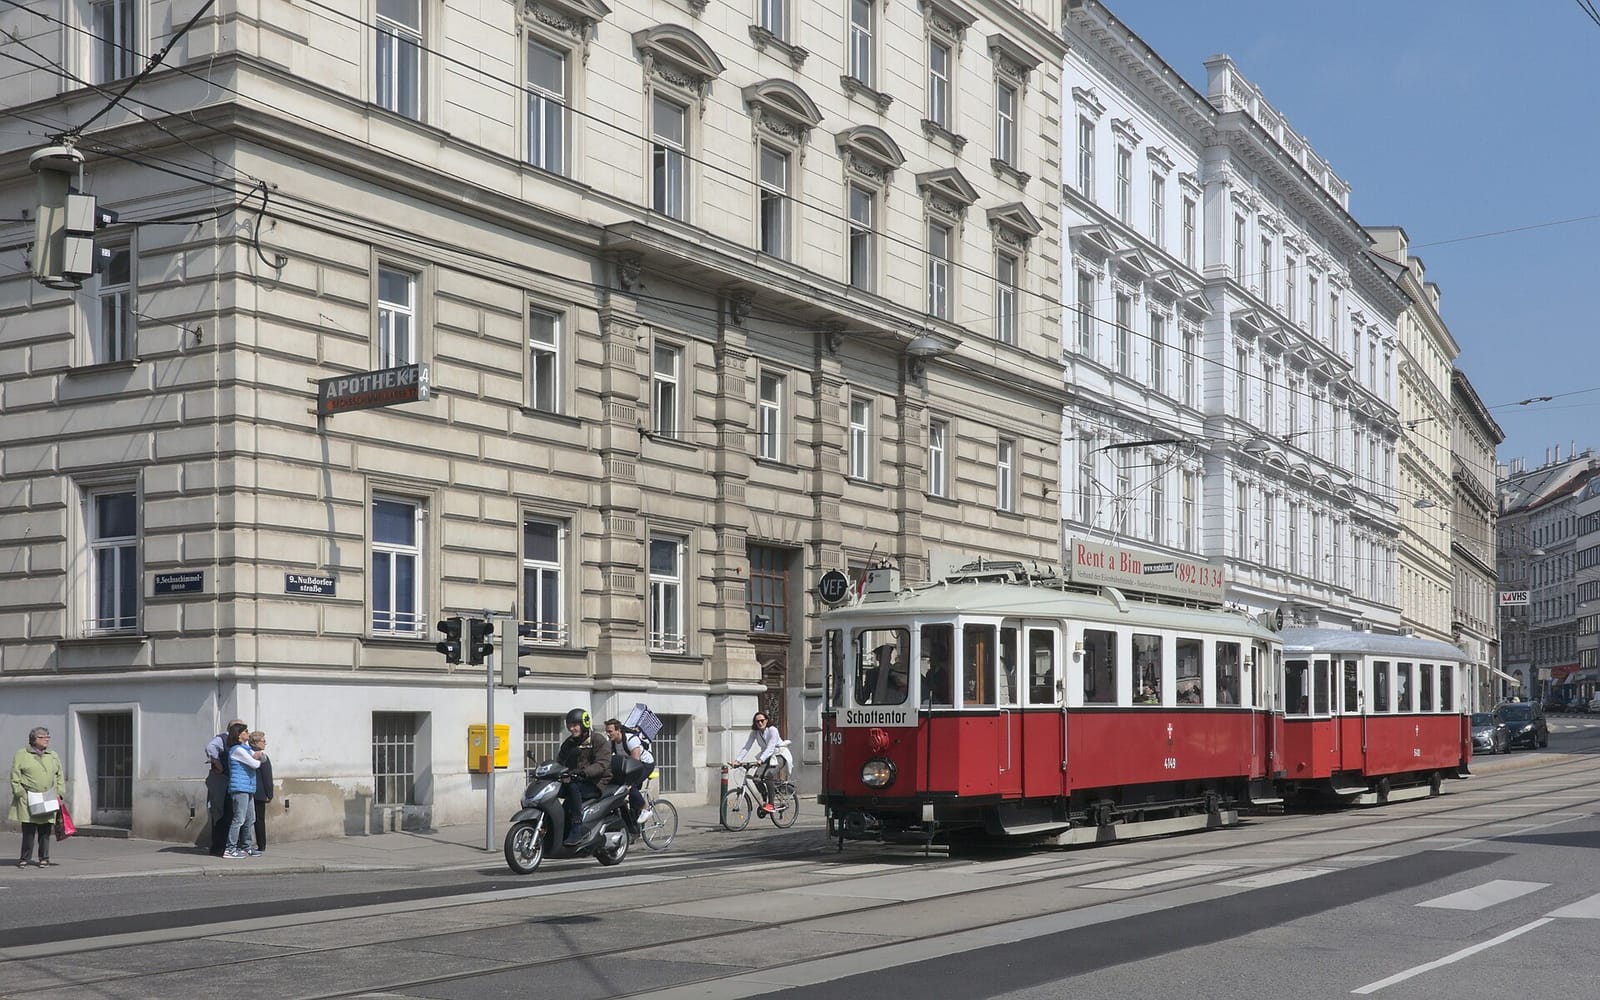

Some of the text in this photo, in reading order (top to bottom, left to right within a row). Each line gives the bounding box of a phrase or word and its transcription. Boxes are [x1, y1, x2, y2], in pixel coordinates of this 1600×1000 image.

[326, 366, 419, 399] APOTHEKE
[1077, 543, 1104, 568] Rent
[1109, 555, 1115, 570] a
[1120, 552, 1141, 575] Bim
[1179, 563, 1196, 584] 892
[1200, 567, 1209, 586] 13
[1211, 569, 1222, 588] 34
[298, 576, 333, 586] Nußdorfer
[823, 579, 844, 595] VEF
[1511, 592, 1527, 601] VHS
[847, 710, 907, 724] Schottentor
[1164, 757, 1176, 769] 4149
